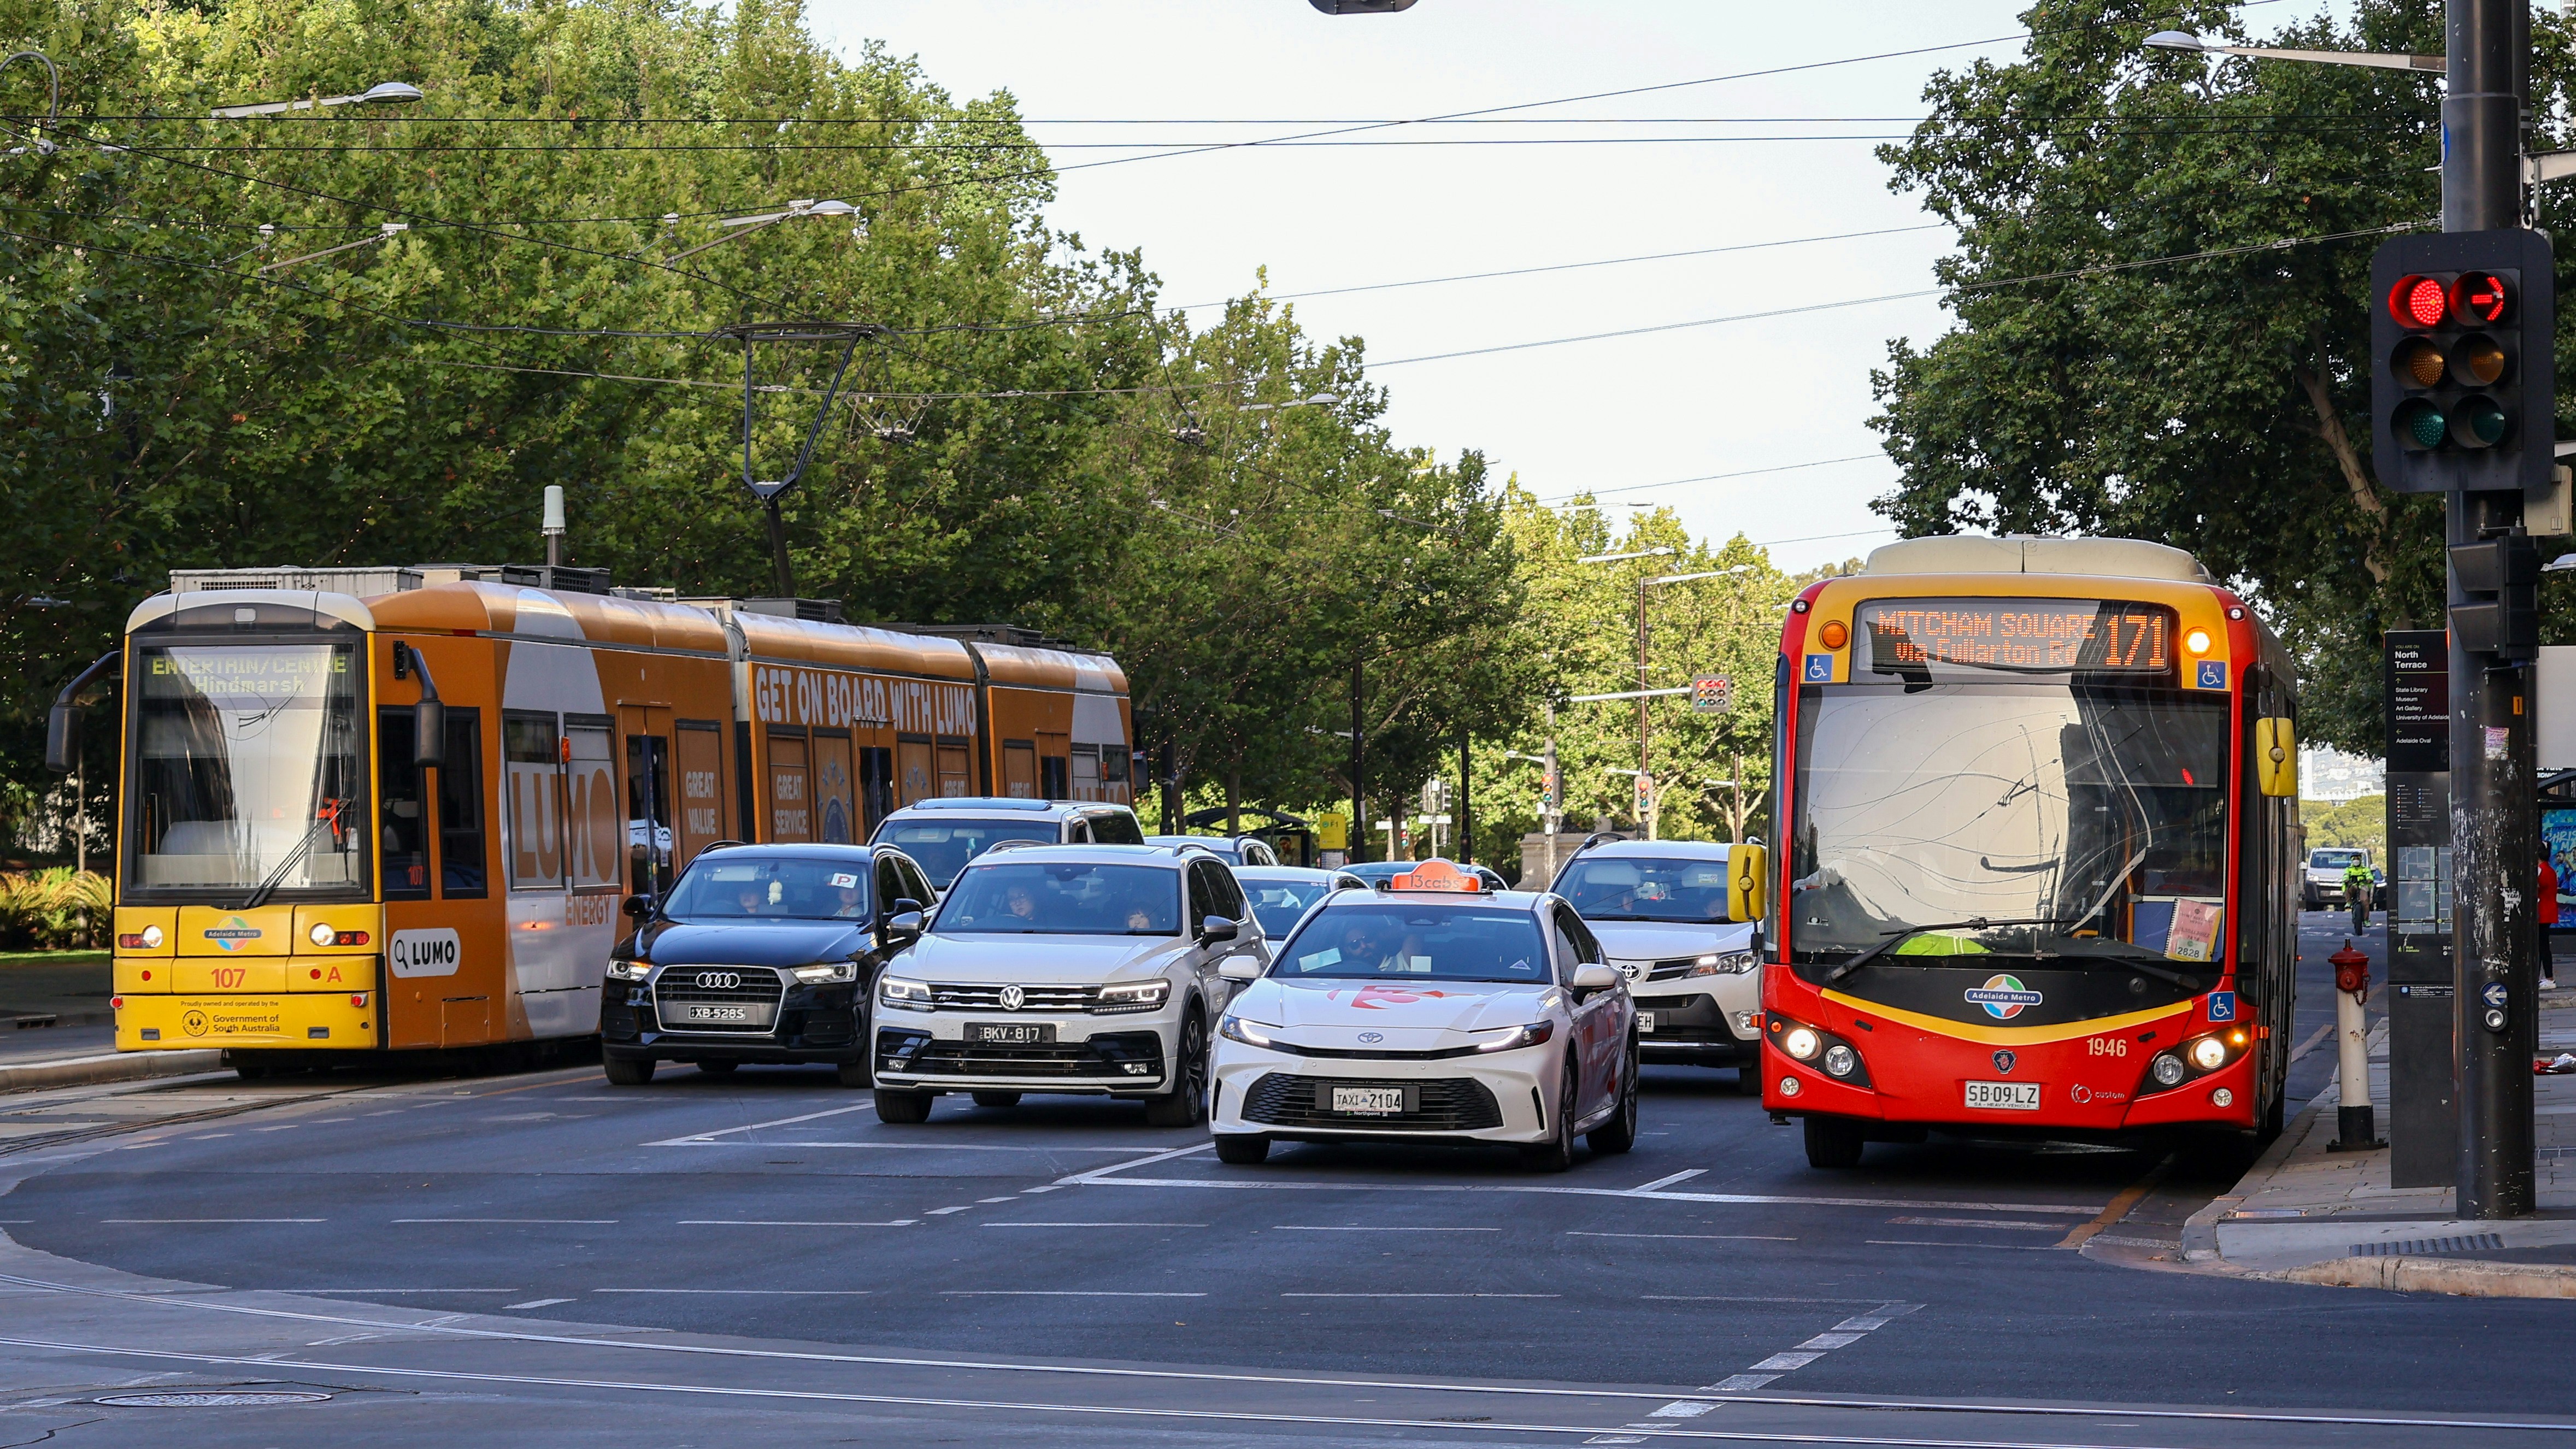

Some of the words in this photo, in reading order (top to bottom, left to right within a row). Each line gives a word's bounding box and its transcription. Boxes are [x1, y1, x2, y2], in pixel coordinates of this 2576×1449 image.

[1878, 610, 1992, 637] MITCHAM
[2000, 612, 2096, 639] SQUARE
[2106, 614, 2166, 667] 171
[1895, 638, 1928, 661] via
[1936, 638, 2040, 664] Fullarton
[2048, 640, 2077, 664] Rd
[195, 676, 304, 693] Hindmarsh
[756, 666, 792, 722] GET
[797, 670, 822, 725] ON
[826, 675, 887, 729] BOARD
[889, 680, 930, 733] WITH
[934, 685, 977, 737] LUMO
[2516, 699, 2520, 712] 1
[686, 771, 714, 798] GREAT
[777, 774, 802, 800] GREAT
[512, 768, 616, 883] LUMO
[688, 808, 716, 834] VALUE
[775, 809, 808, 835] SERVICE
[408, 865, 424, 885] 107
[836, 876, 851, 885] P
[1409, 875, 1460, 889] 13cabs
[566, 894, 610, 926] ENERGY
[413, 940, 455, 965] LUMO
[2177, 947, 2199, 958] 2828
[211, 968, 246, 988] 107
[326, 966, 342, 983] A
[1972, 992, 2009, 1000] Adelaide
[270, 1014, 279, 1022] of
[2087, 1038, 2127, 1057] 1946
[1337, 1094, 1359, 1106] TAXI
[1369, 1093, 1401, 1108] 2104
